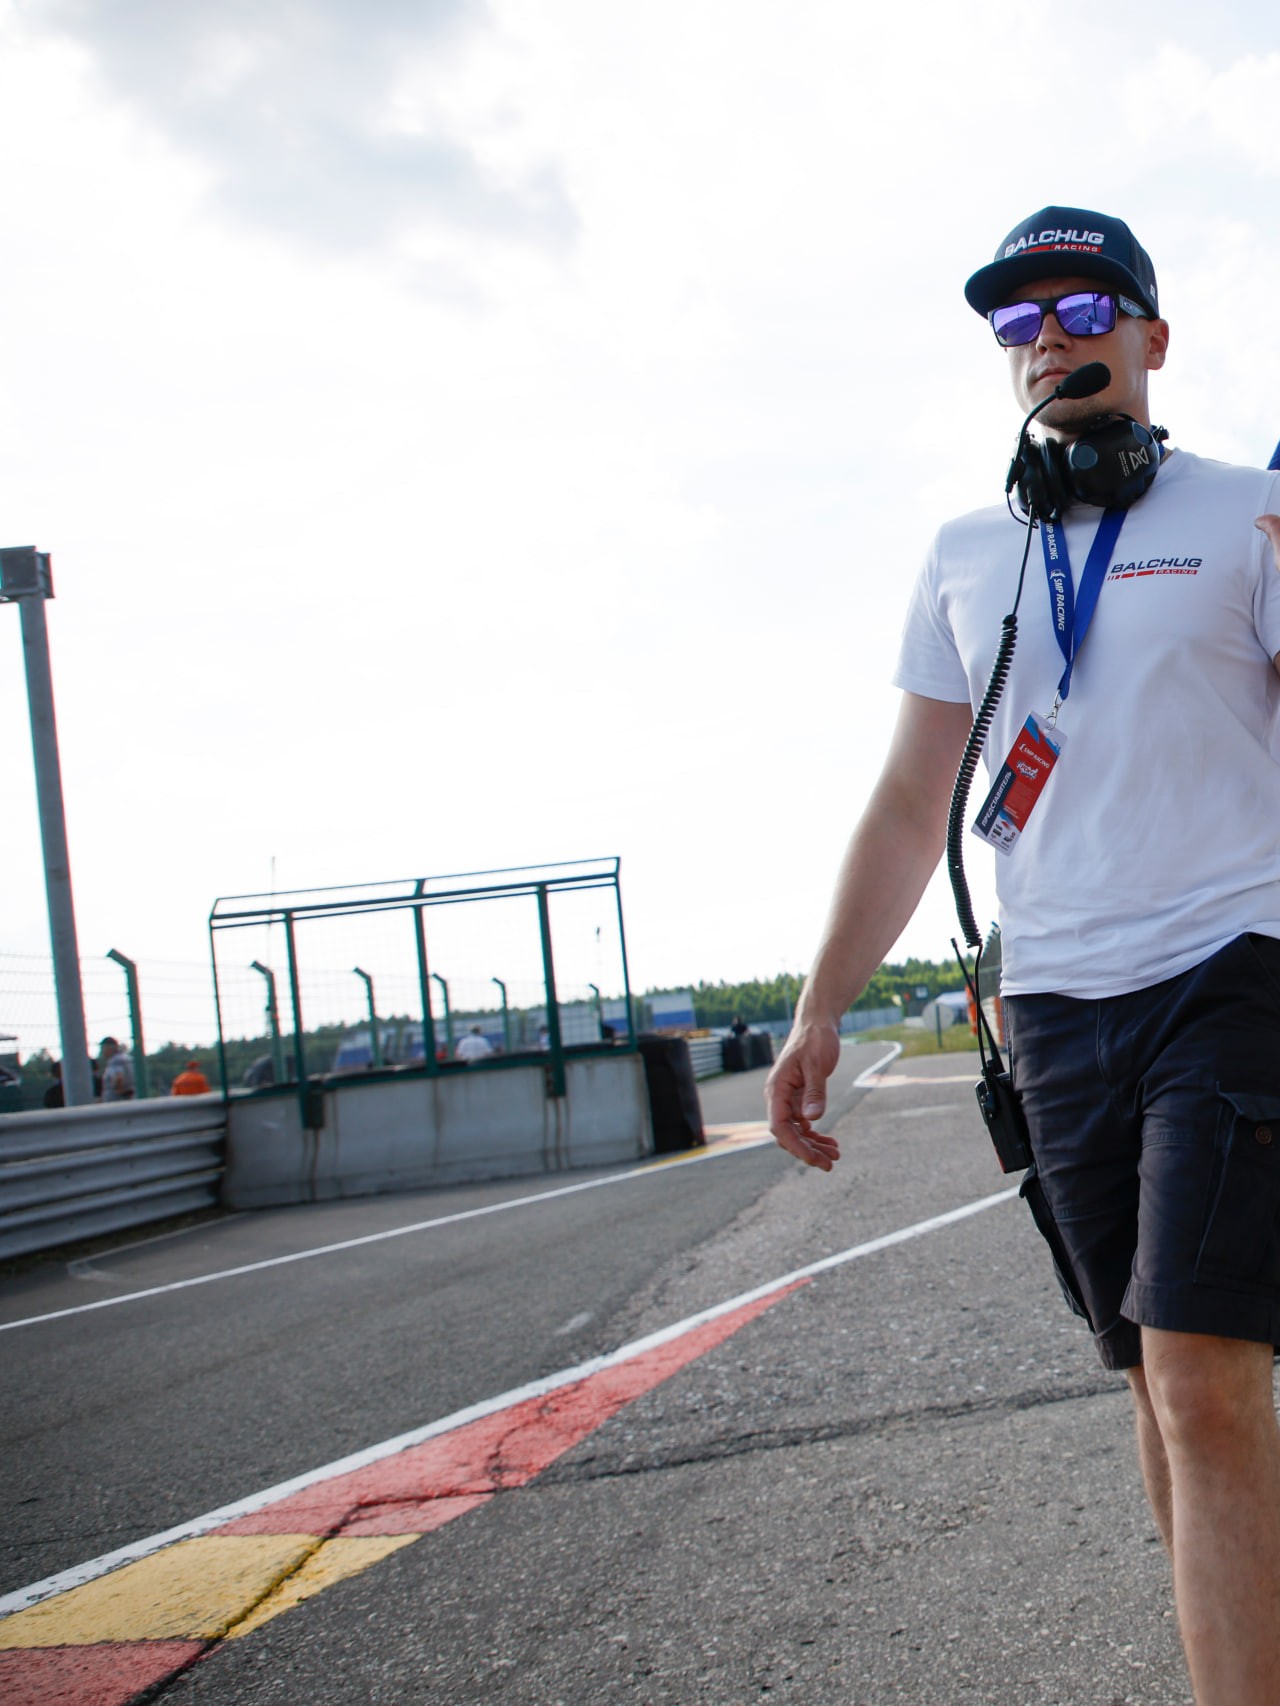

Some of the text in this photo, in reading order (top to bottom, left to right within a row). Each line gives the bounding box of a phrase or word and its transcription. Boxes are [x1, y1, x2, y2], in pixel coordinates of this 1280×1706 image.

[1004, 229, 1105, 258] BALCHUG
[1054, 244, 1099, 252] RACING
[1047, 533, 1059, 560] RACING
[1110, 558, 1203, 574] BALCHUG
[1053, 578, 1066, 632] SMP RACING
[981, 770, 1013, 827] ПРЕДСТАВИТЕЛЬ
